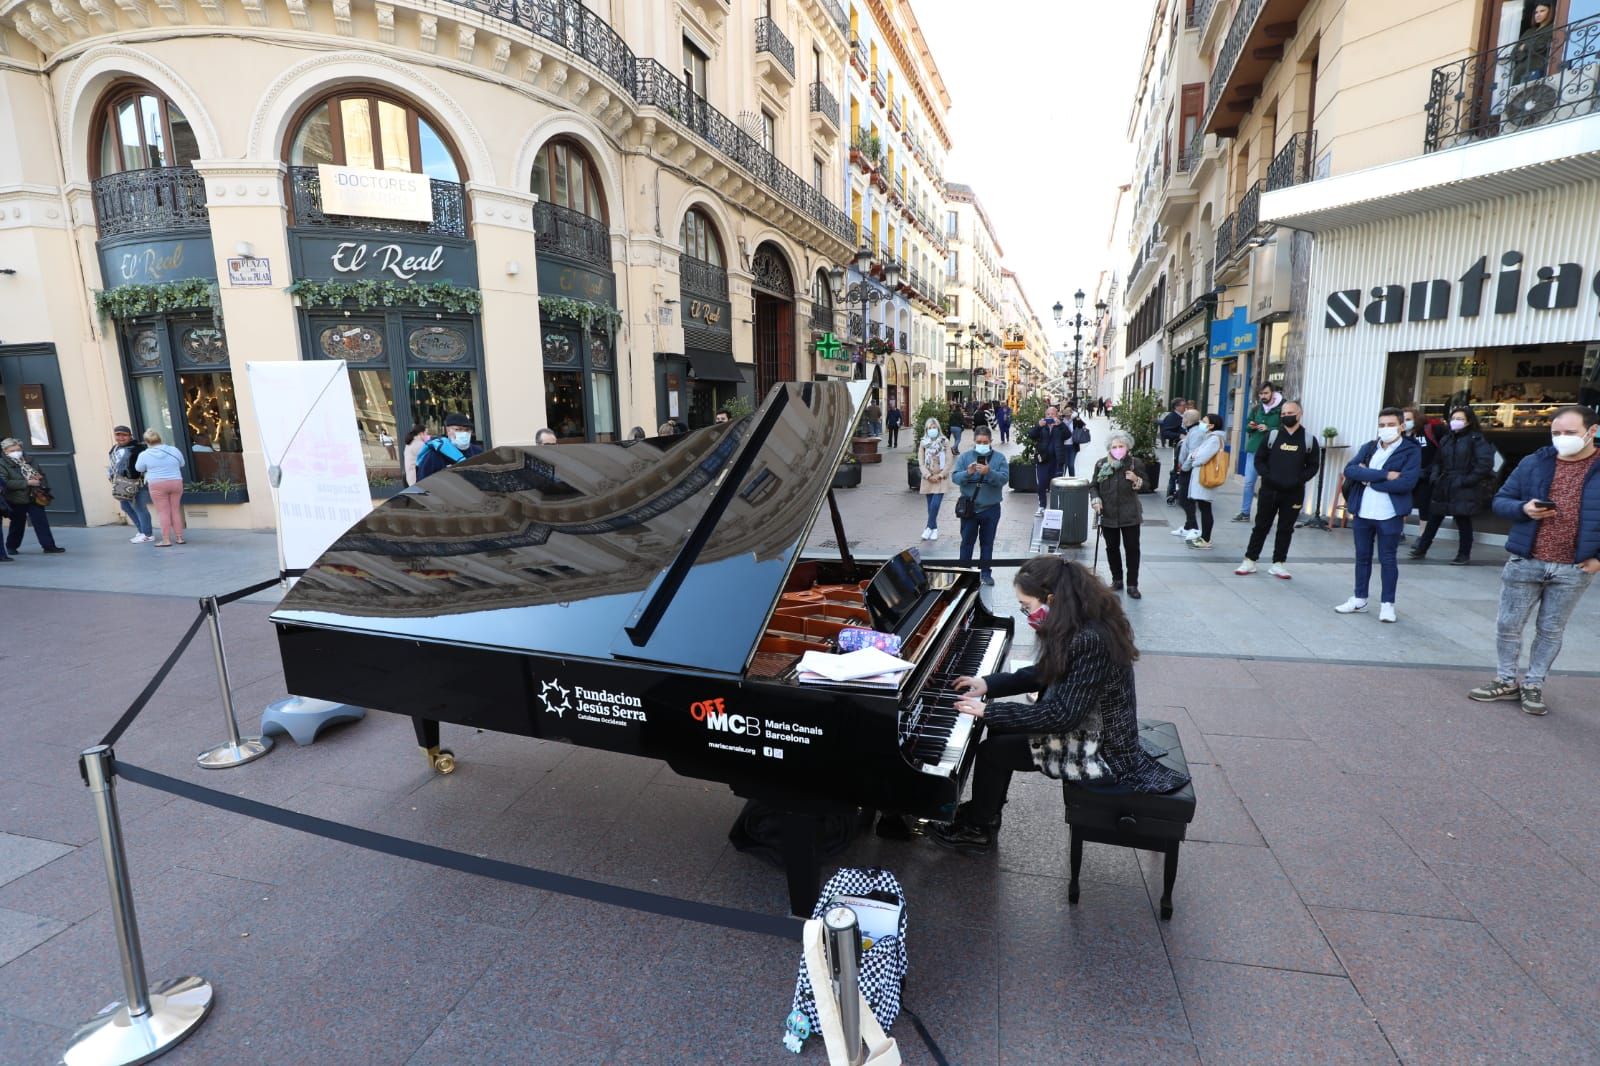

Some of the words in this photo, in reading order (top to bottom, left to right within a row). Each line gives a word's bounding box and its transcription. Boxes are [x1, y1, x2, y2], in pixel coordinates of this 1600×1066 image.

[337, 173, 416, 193] DOCTORES
[121, 253, 137, 279] El
[140, 239, 184, 279] Real
[331, 242, 367, 272] El
[372, 244, 444, 280] Real
[1325, 250, 1600, 328] santia
[690, 299, 701, 318] El
[702, 303, 720, 325] Real
[1233, 333, 1253, 347] grill
[575, 686, 642, 707] Fundacion
[576, 700, 610, 716] Jesús
[611, 705, 647, 722] Serra
[690, 697, 726, 721] OFF
[707, 712, 761, 736] MCB
[765, 719, 791, 731] Maria
[791, 723, 823, 735] Canals
[765, 730, 810, 744] Barcelona
[708, 742, 756, 755] mariacanals.org
